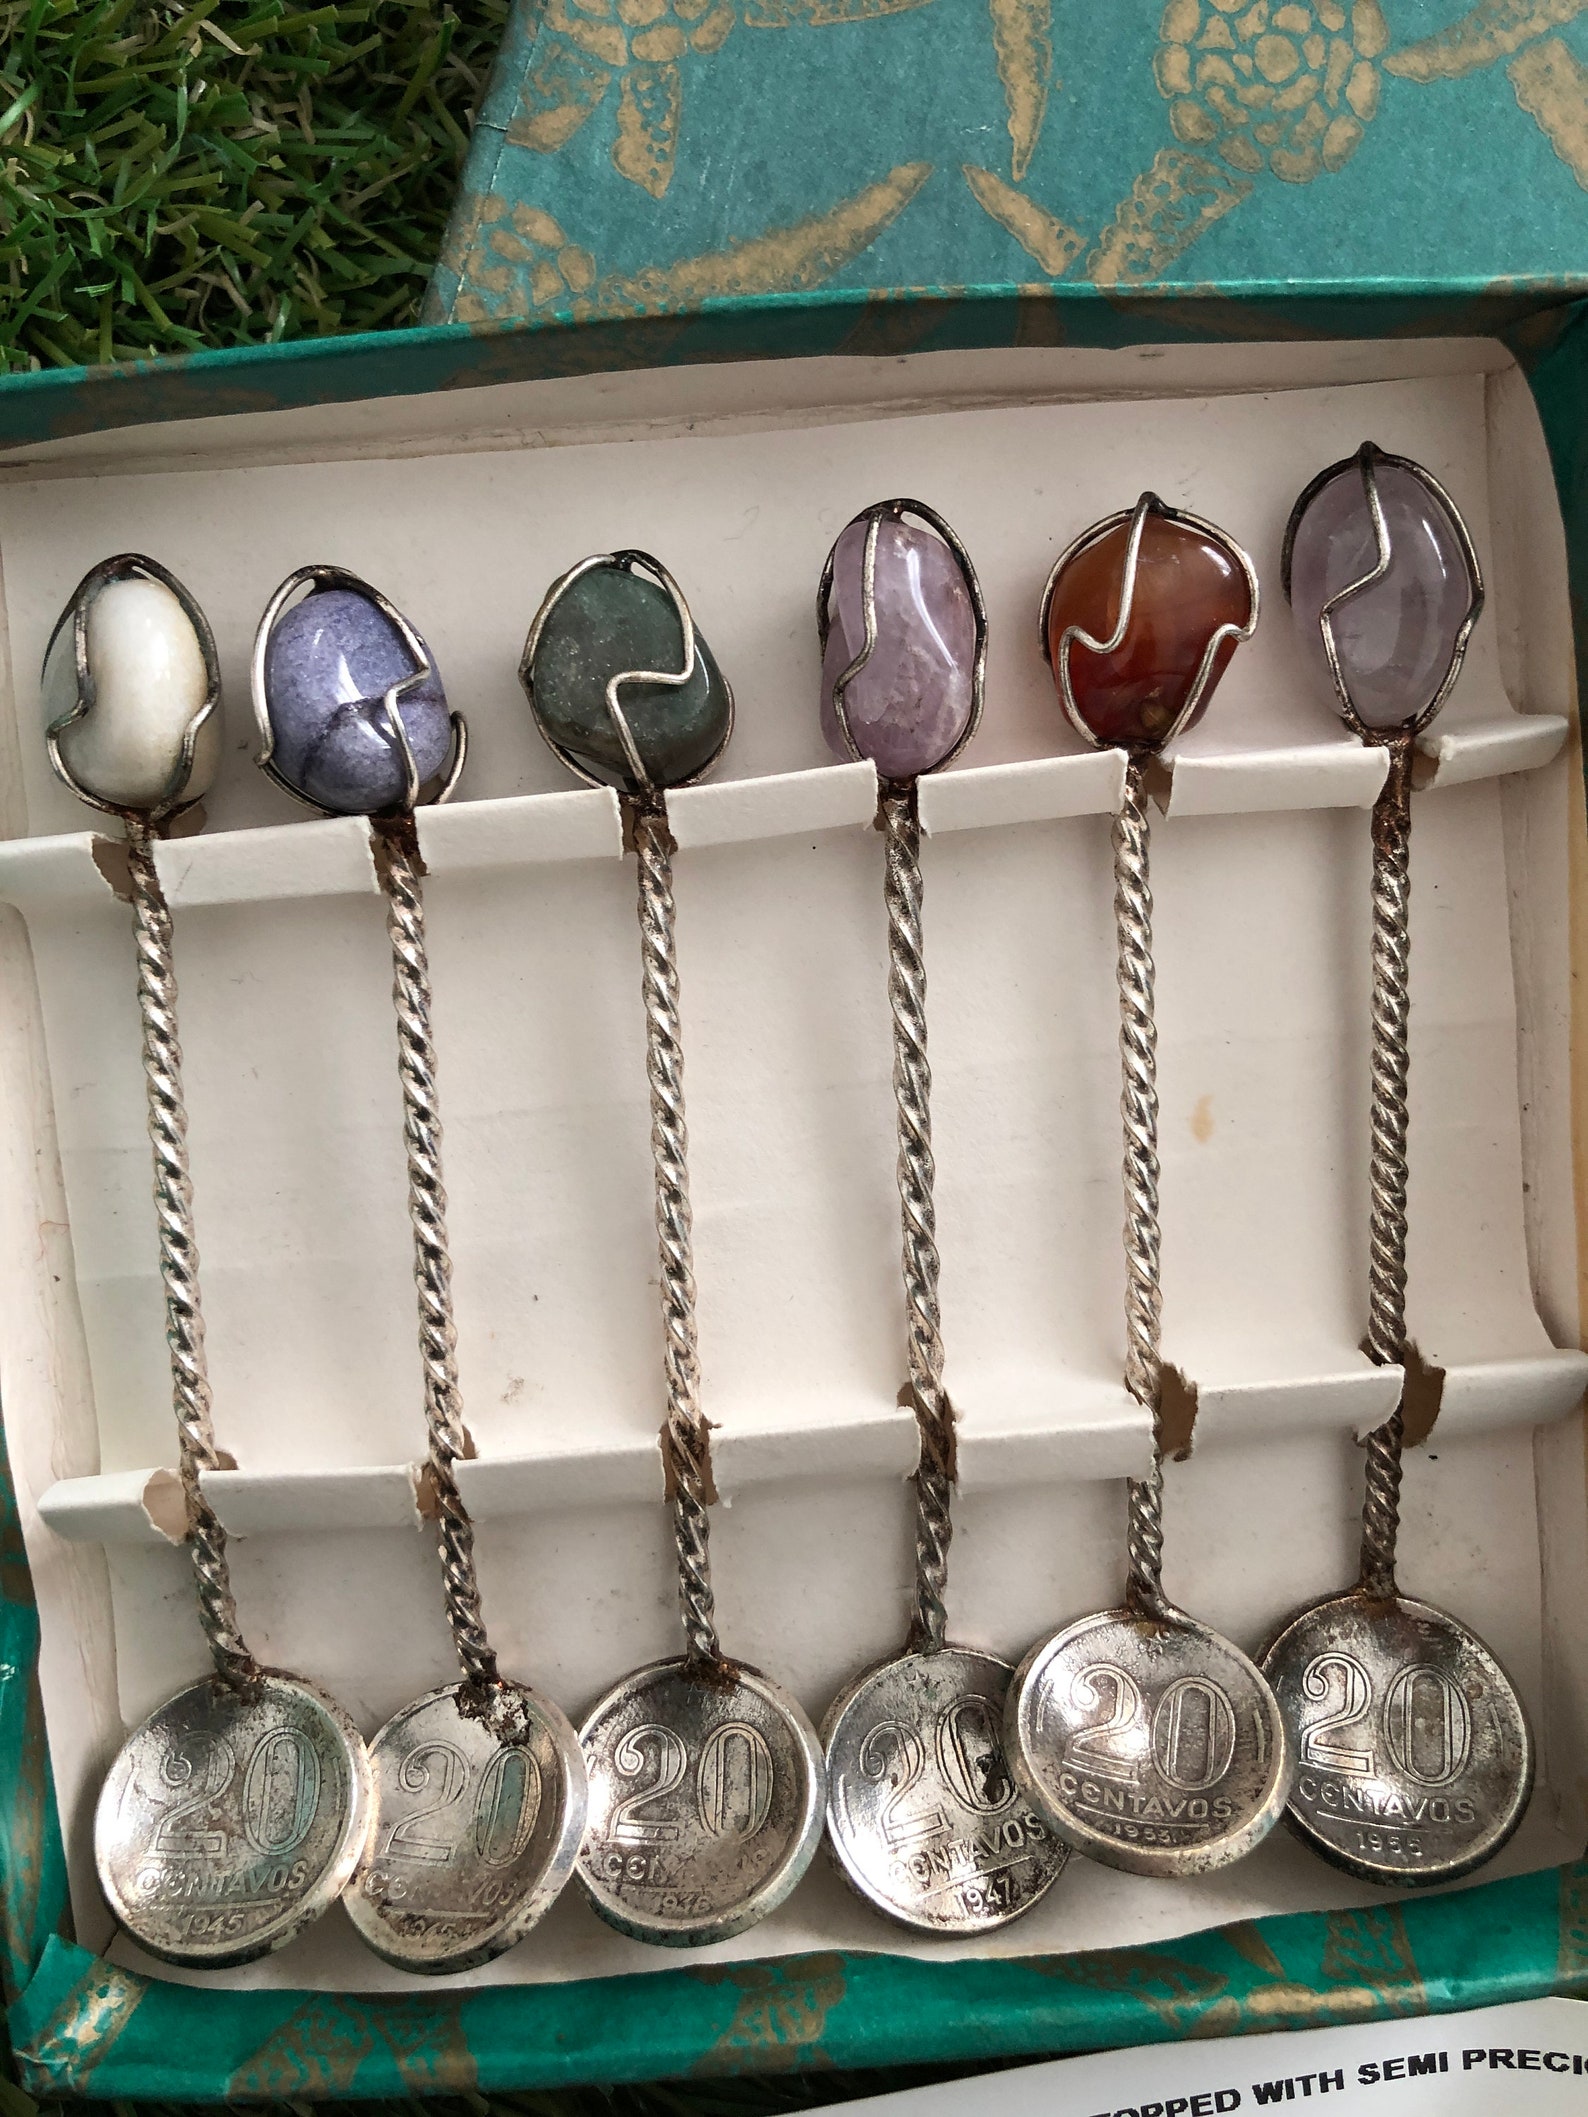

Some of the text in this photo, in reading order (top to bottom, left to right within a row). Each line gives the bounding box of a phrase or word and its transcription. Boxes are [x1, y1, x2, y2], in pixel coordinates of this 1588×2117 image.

[1062, 1662, 1236, 1791] 20
[1299, 1651, 1471, 1787] 20
[145, 1725, 321, 1857] 20
[376, 1739, 542, 1868] 20
[606, 1722, 774, 1845] 20
[860, 1694, 1019, 1844] 20
[1059, 1773, 1233, 1819] CENTAVOS
[1299, 1776, 1476, 1824] CENTAVOS
[136, 1861, 309, 1897] CENTAVOS
[889, 1812, 1047, 1883] CENTAVOS
[182, 1913, 245, 1935] 1945
[954, 1875, 1013, 1916] 1947
[1090, 2049, 1588, 2117] PPED WITH SEMI PRECI
